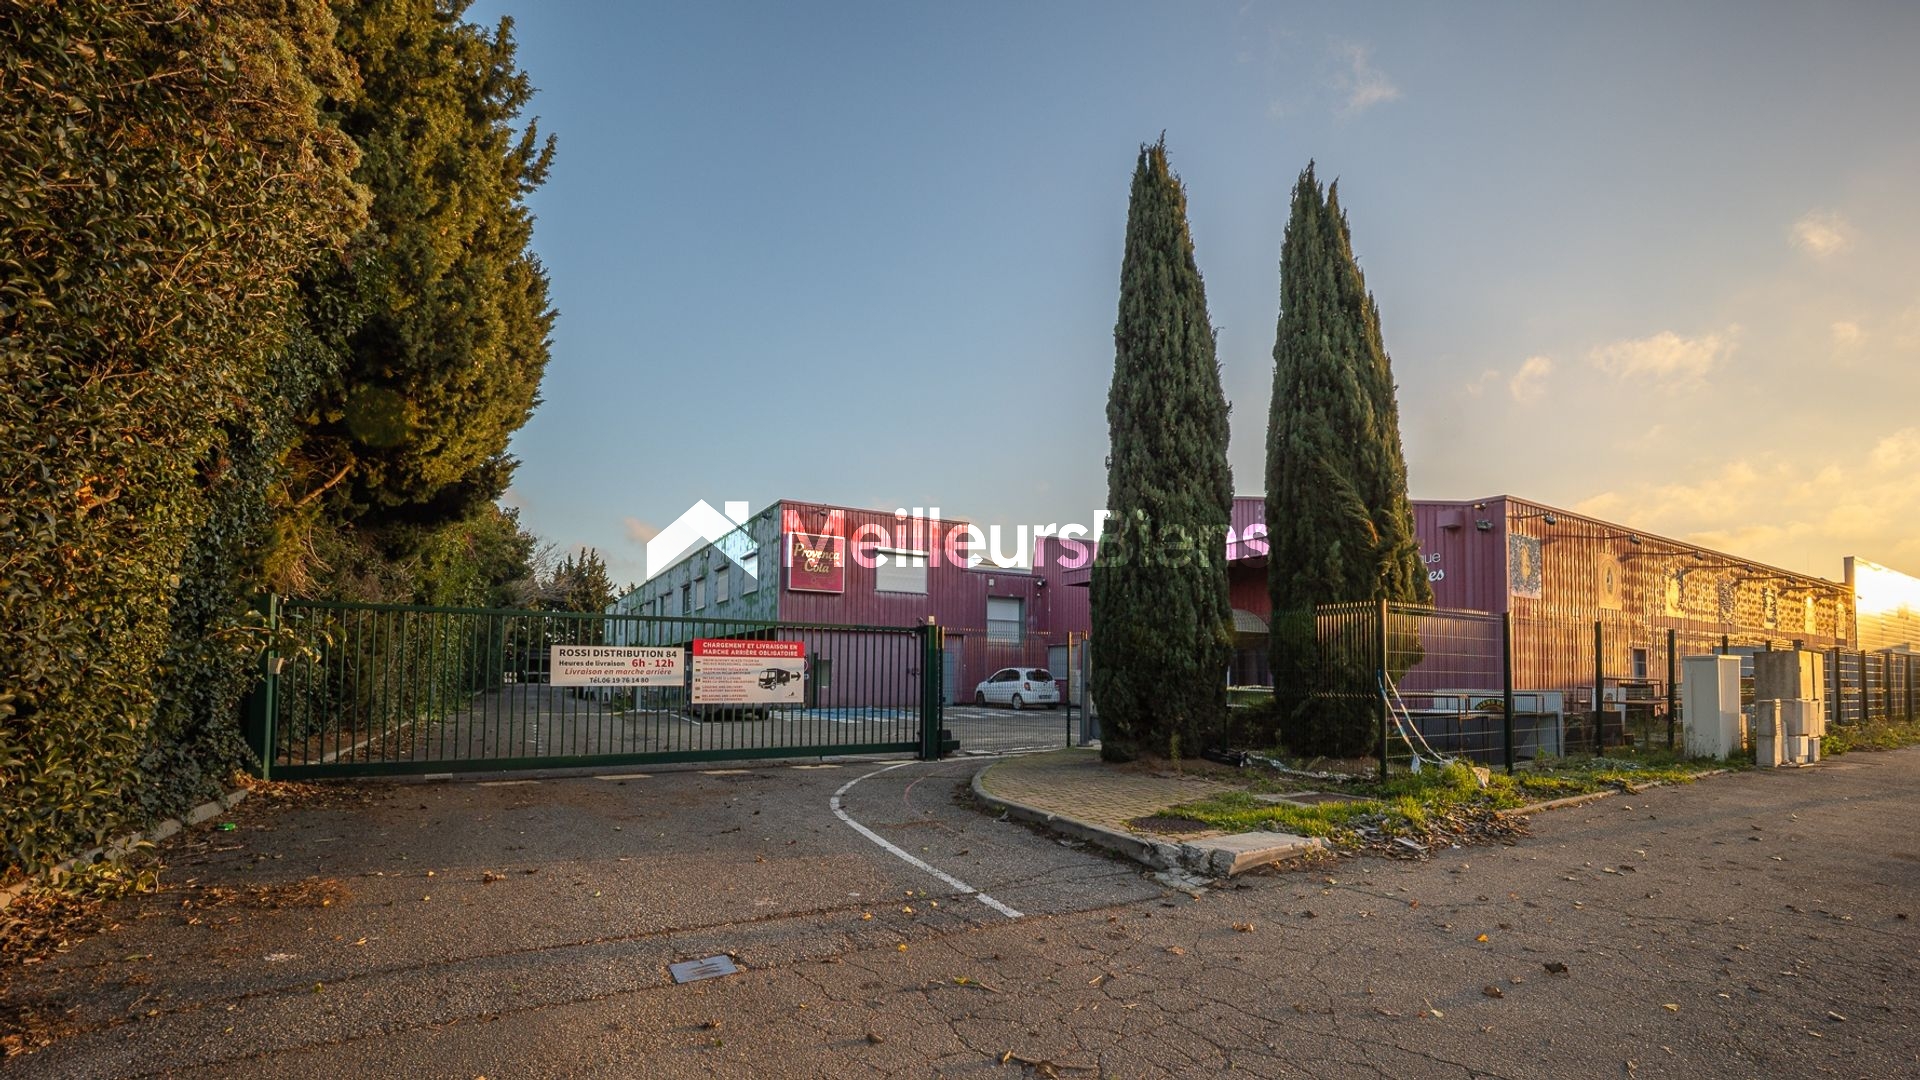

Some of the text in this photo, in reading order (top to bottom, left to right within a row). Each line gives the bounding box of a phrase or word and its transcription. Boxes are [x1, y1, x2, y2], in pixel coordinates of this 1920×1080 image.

[794, 542, 840, 561] Provença
[804, 558, 829, 573] Cola
[559, 649, 677, 658] ROSSI DISTRIBUTION 84
[730, 648, 757, 656] ARRIÈRE
[631, 658, 645, 668] 6h
[654, 658, 674, 668] 12h
[564, 668, 602, 676] Livraison
[615, 668, 644, 676] marche
[645, 668, 672, 676] arrière
